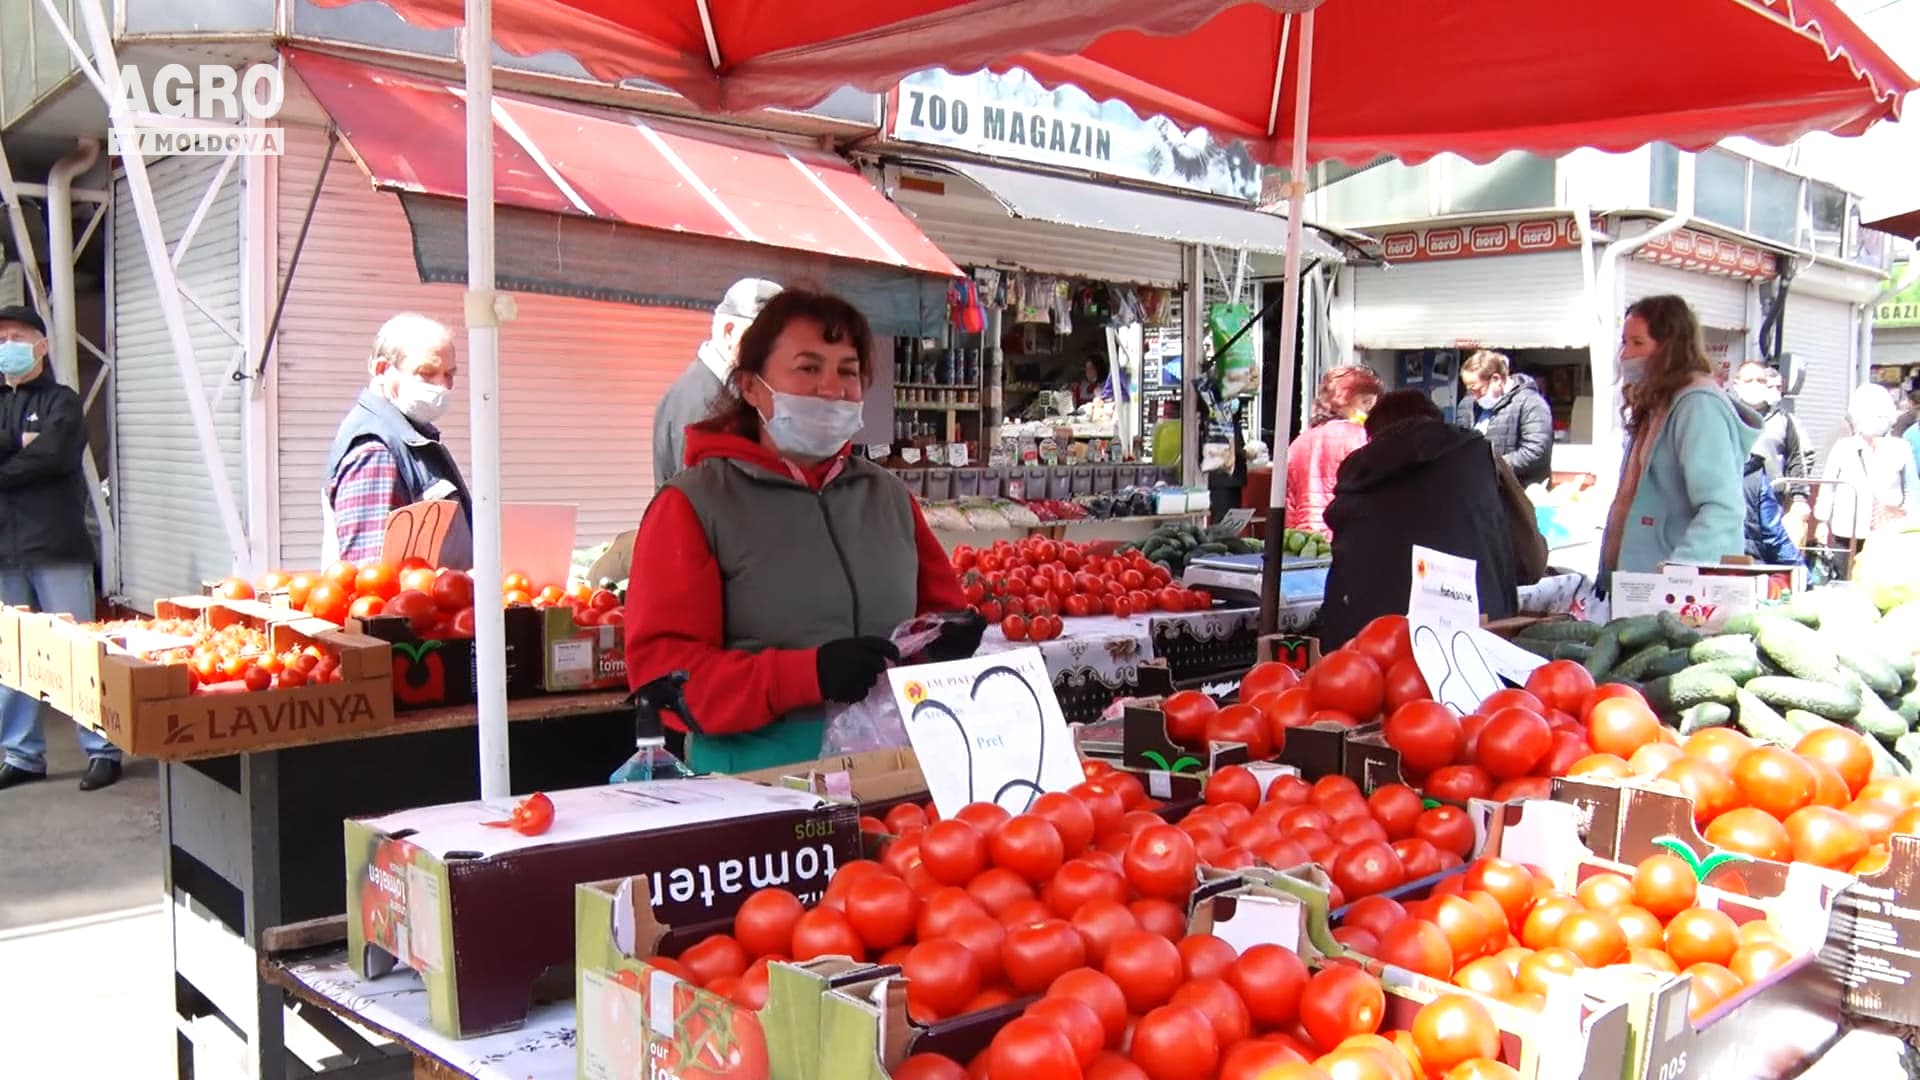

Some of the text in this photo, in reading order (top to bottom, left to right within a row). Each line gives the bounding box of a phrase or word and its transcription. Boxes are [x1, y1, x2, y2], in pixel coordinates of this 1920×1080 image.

[910, 91, 1111, 161] ZOO MAGAZIN
[1475, 229, 1504, 247] nord
[1522, 226, 1552, 244] nord
[794, 819, 834, 840] TROS
[650, 1042, 669, 1061] our
